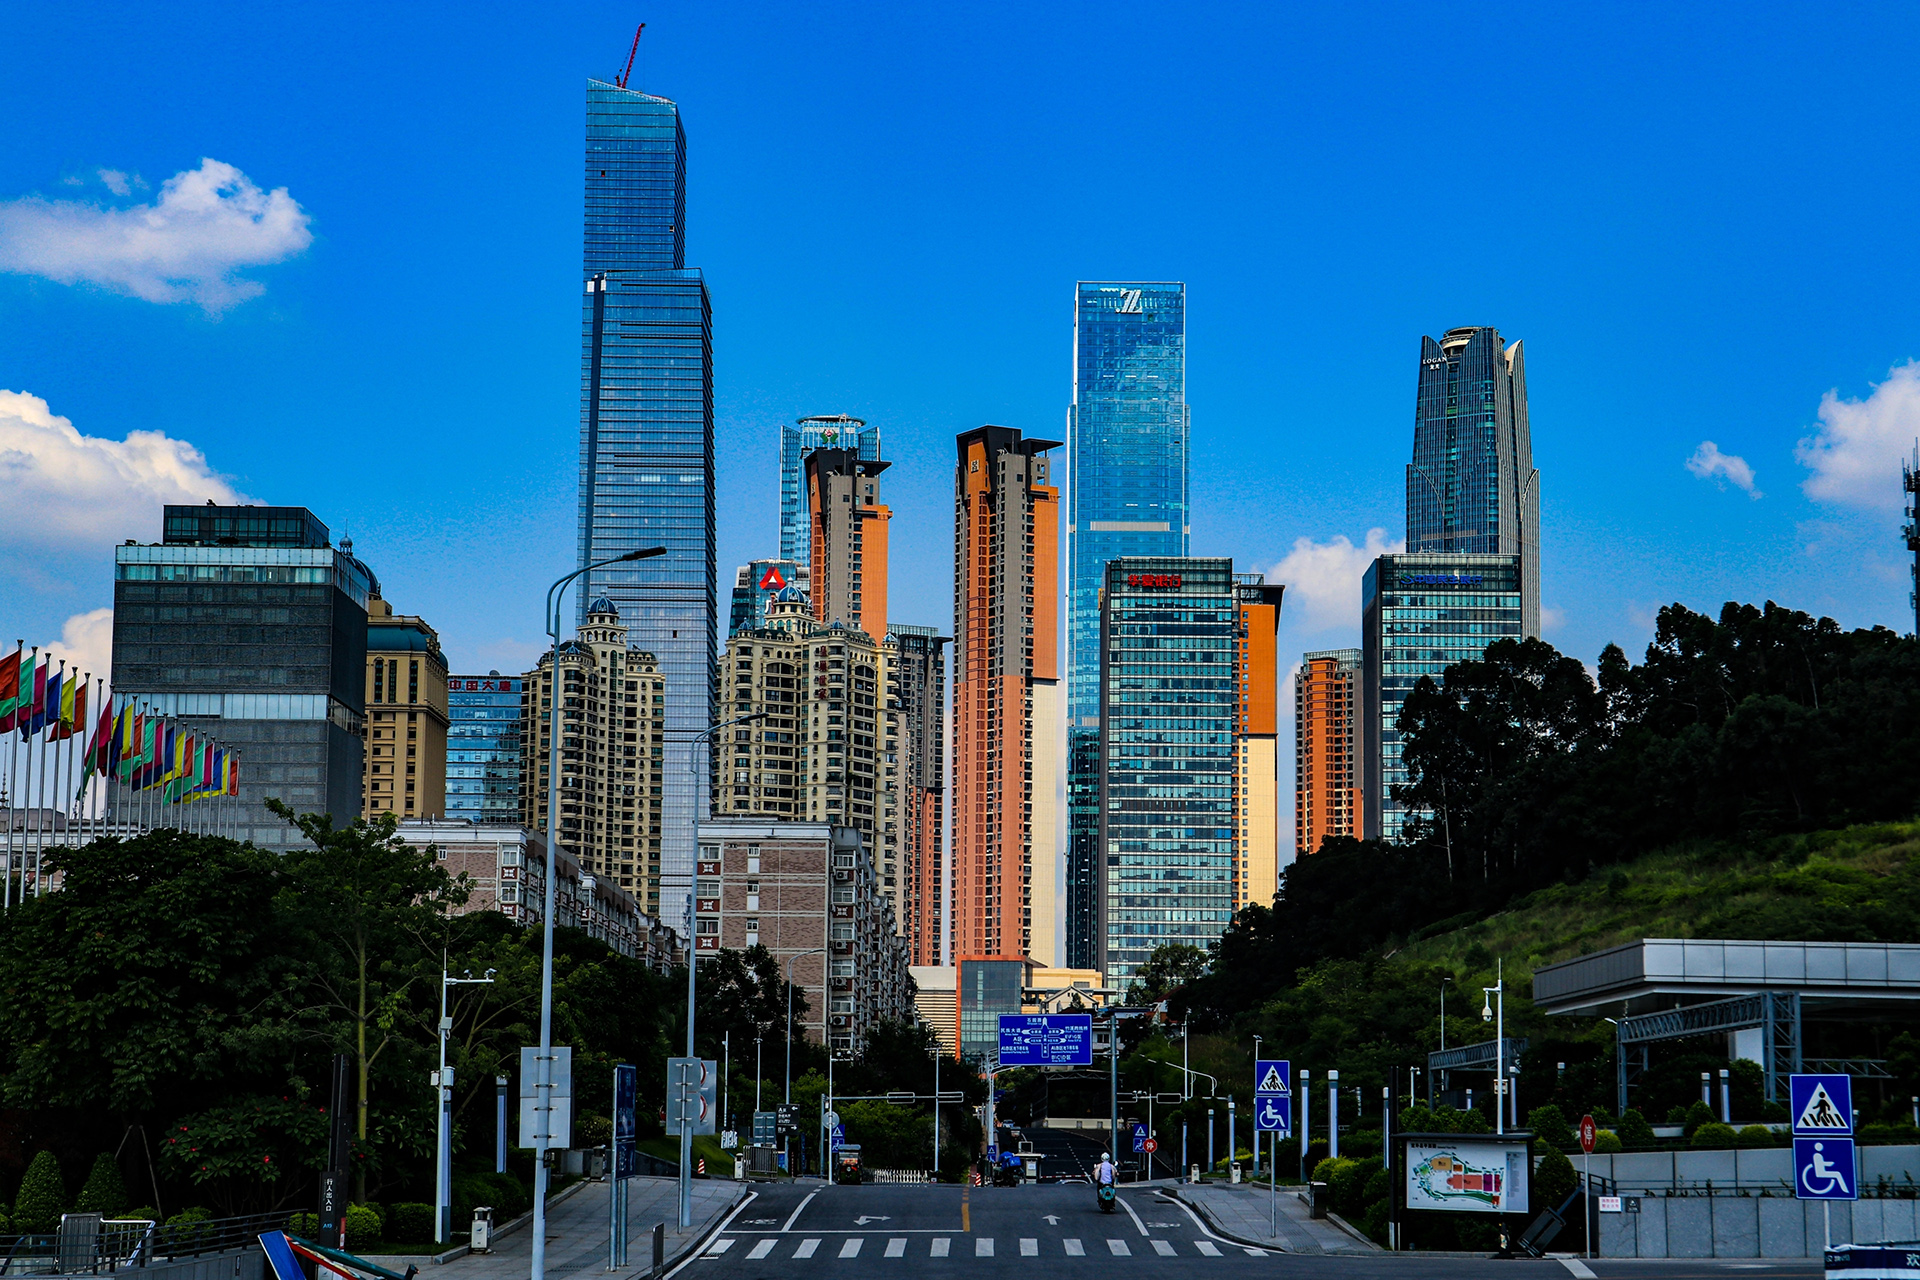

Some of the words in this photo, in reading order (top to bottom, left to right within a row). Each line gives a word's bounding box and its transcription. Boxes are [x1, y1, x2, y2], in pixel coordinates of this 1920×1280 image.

[1127, 574, 1182, 587] 华夏银行
[1414, 574, 1482, 585] 中国民生银行
[449, 679, 511, 691] 中国大唐
[1584, 1124, 1592, 1145] 停
[325, 1178, 333, 1212] 行人出入口
